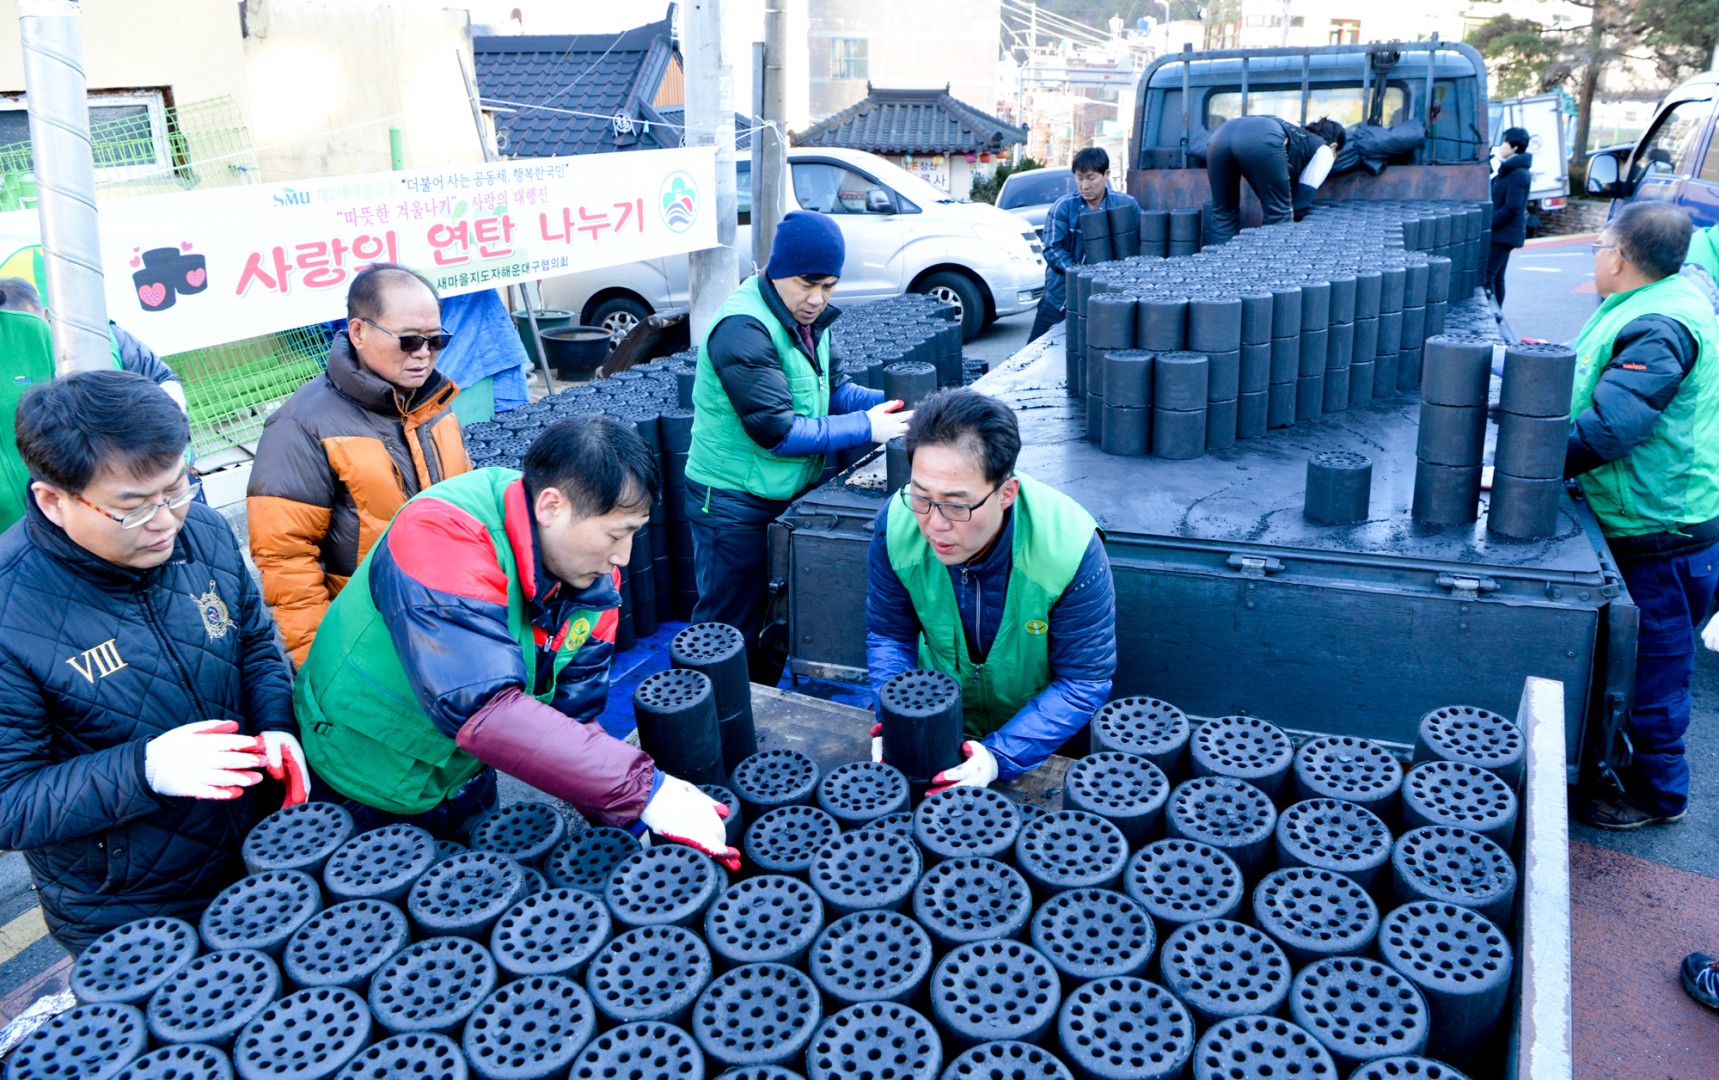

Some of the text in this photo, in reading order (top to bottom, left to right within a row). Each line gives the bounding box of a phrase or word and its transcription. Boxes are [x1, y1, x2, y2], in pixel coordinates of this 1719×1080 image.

[272, 190, 312, 208] SMU
[317, 180, 398, 203] 제2새마을운동
[447, 173, 471, 190] 사는
[336, 185, 549, 228] "따뜻한 겨울나기" 사랑의 대행진
[235, 197, 644, 296] 사랑의 연탄 나누기
[436, 255, 570, 291] 새마을지도자해운대구협의회
[65, 638, 129, 684] VIII
